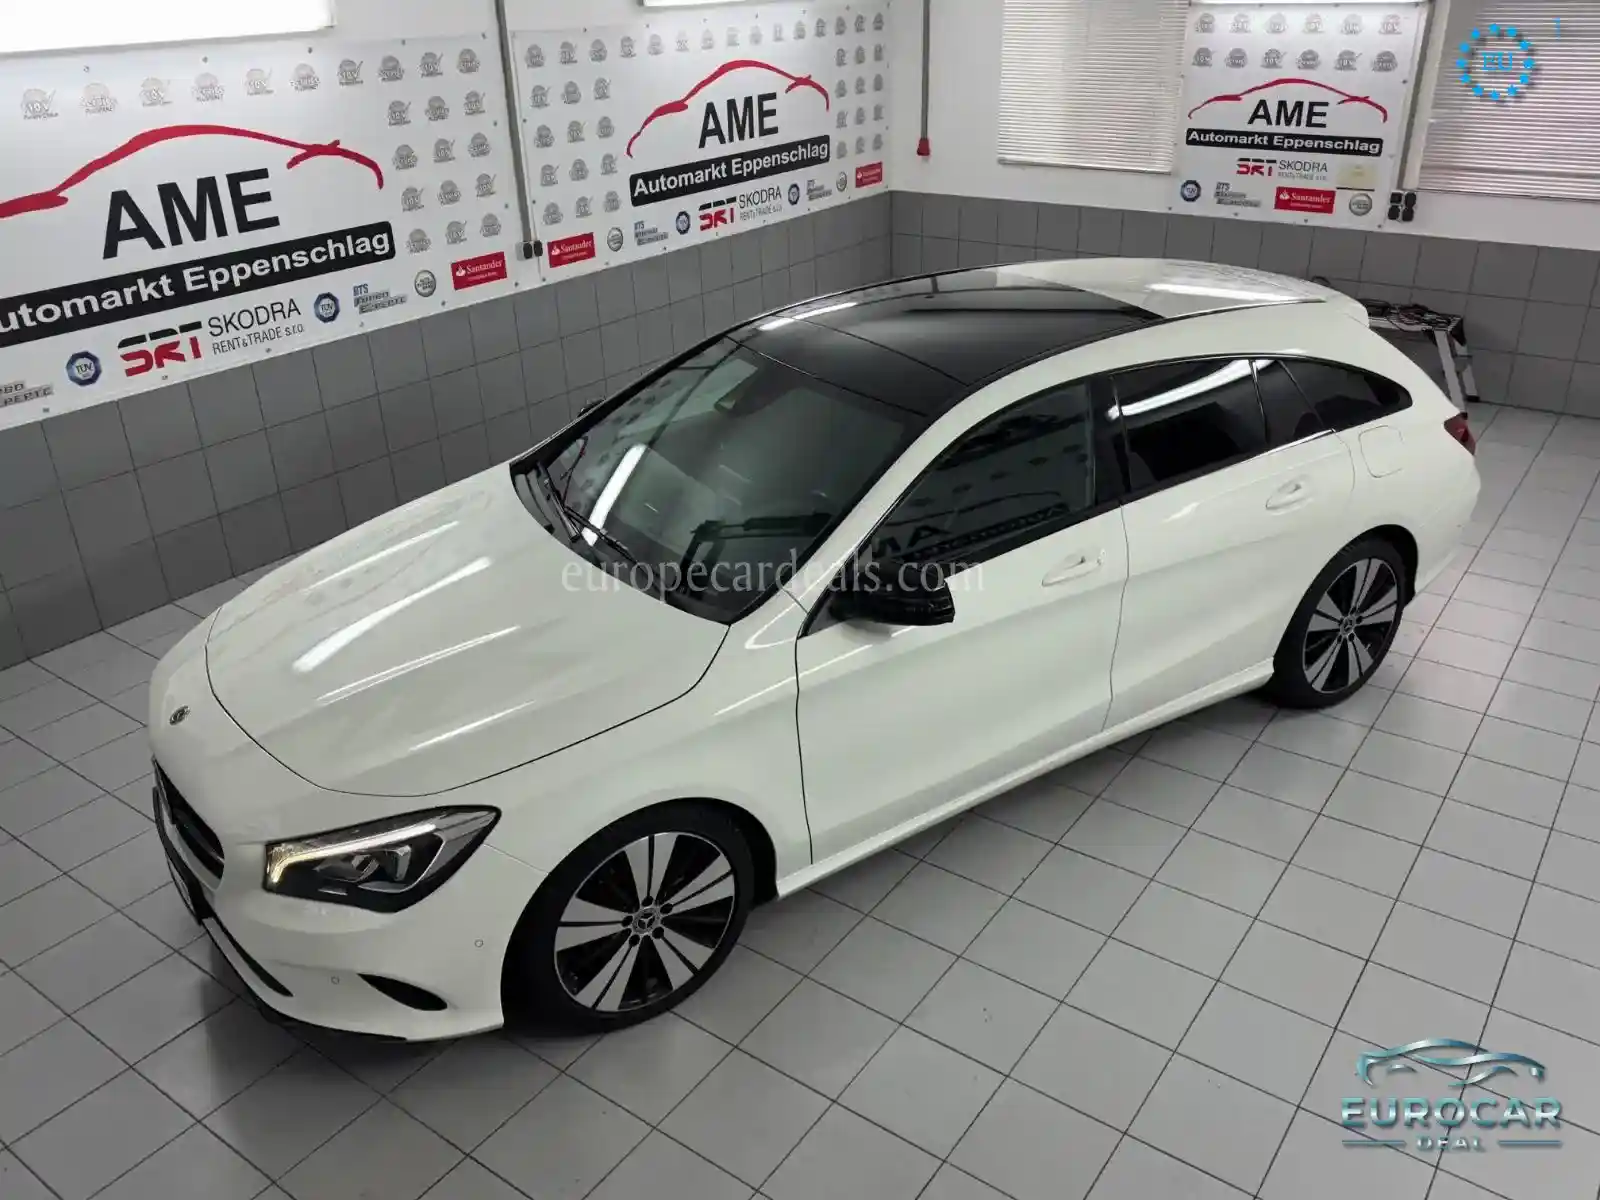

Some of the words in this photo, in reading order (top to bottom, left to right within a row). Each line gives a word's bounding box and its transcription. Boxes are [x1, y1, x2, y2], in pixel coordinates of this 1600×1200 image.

[699, 92, 779, 149] AME
[1247, 99, 1329, 128] AME
[1188, 131, 1268, 146] Automarkt
[1273, 135, 1380, 153] Eppenschlag
[633, 163, 727, 197] Automarkt
[731, 142, 828, 177] Eppenschlag
[1278, 160, 1328, 172] SKODRA
[739, 186, 782, 209] SKODRA
[1291, 192, 1332, 203] Santander
[102, 167, 280, 260] AME
[698, 196, 737, 231] SRT
[560, 239, 592, 254] Santander
[182, 231, 390, 292] Eppenschlag
[466, 260, 503, 274] Santander
[353, 283, 369, 296] BTS
[208, 298, 301, 337] SKODRA
[117, 320, 202, 378] SRT
[212, 326, 282, 355] RENT&TRADE
